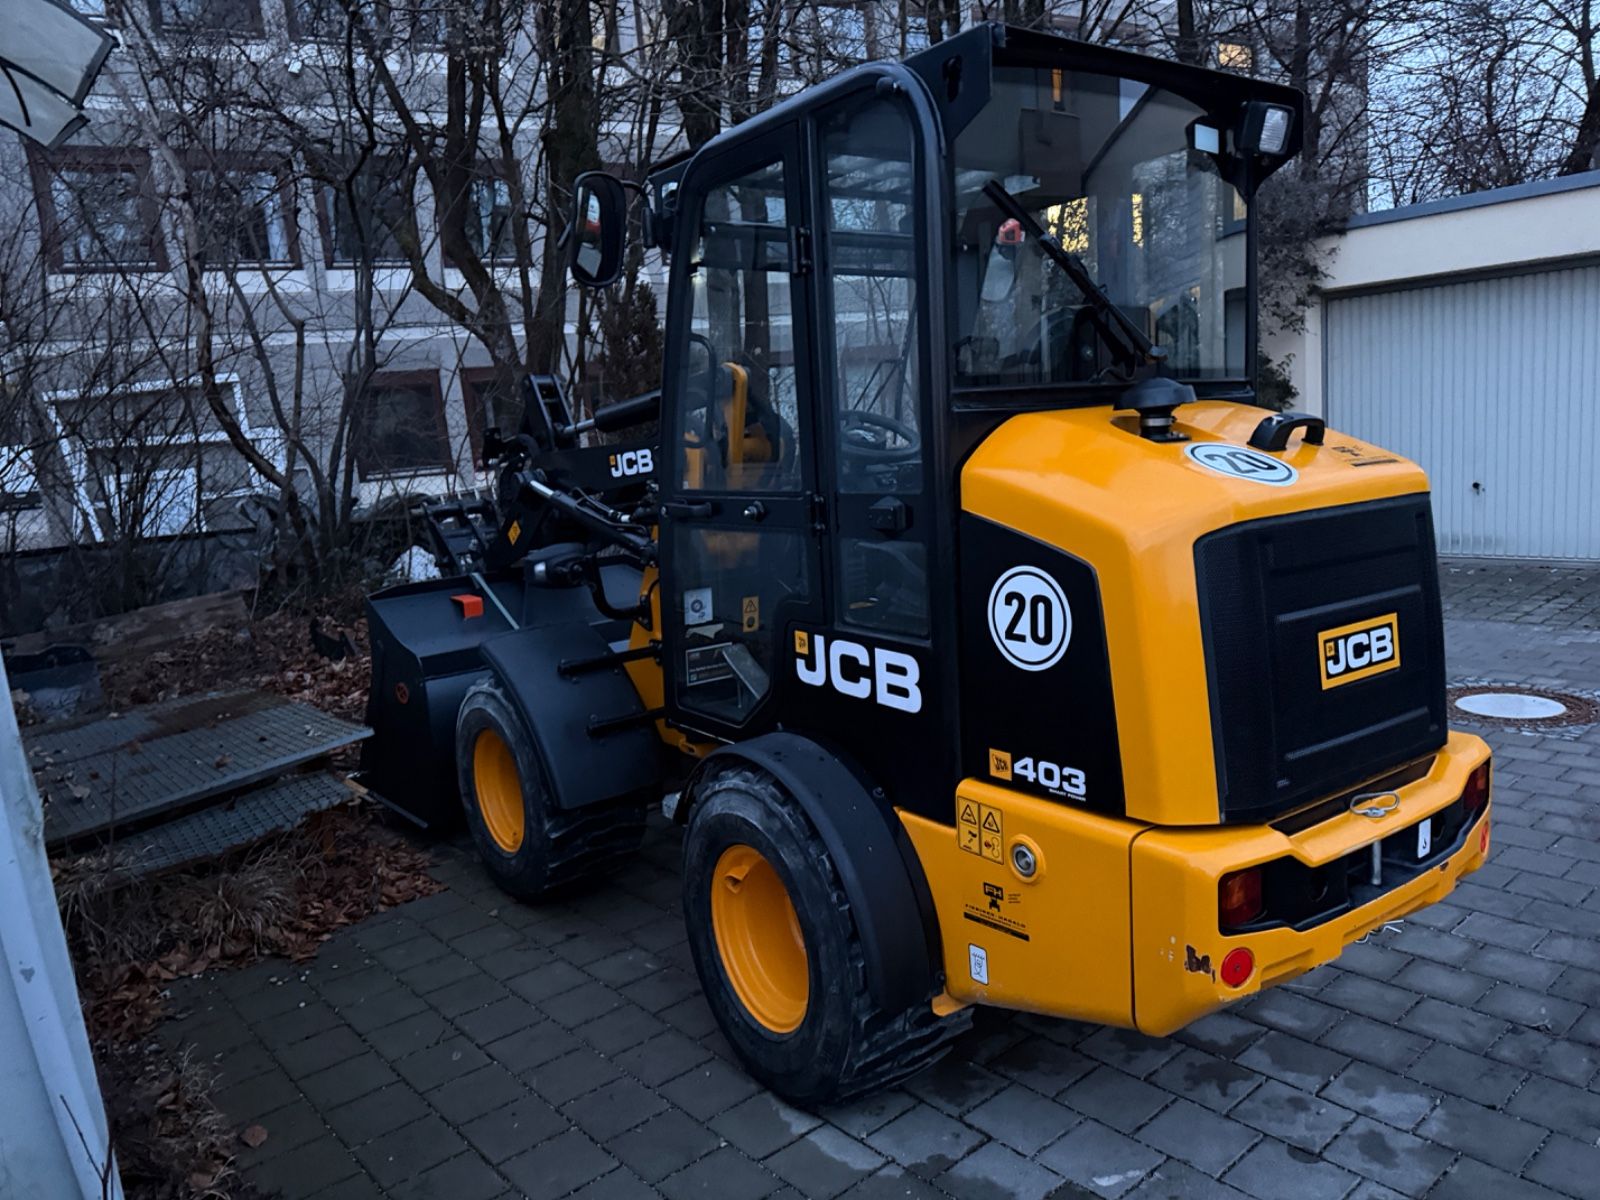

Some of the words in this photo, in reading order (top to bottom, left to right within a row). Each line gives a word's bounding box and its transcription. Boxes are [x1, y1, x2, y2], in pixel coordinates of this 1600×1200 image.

[611, 448, 654, 478] JCB
[1204, 450, 1279, 474] 20
[1004, 590, 1053, 646] 20
[1326, 626, 1394, 675] JCB
[796, 634, 922, 714] JCB
[1013, 756, 1086, 796] 403
[985, 885, 1002, 898] FH
